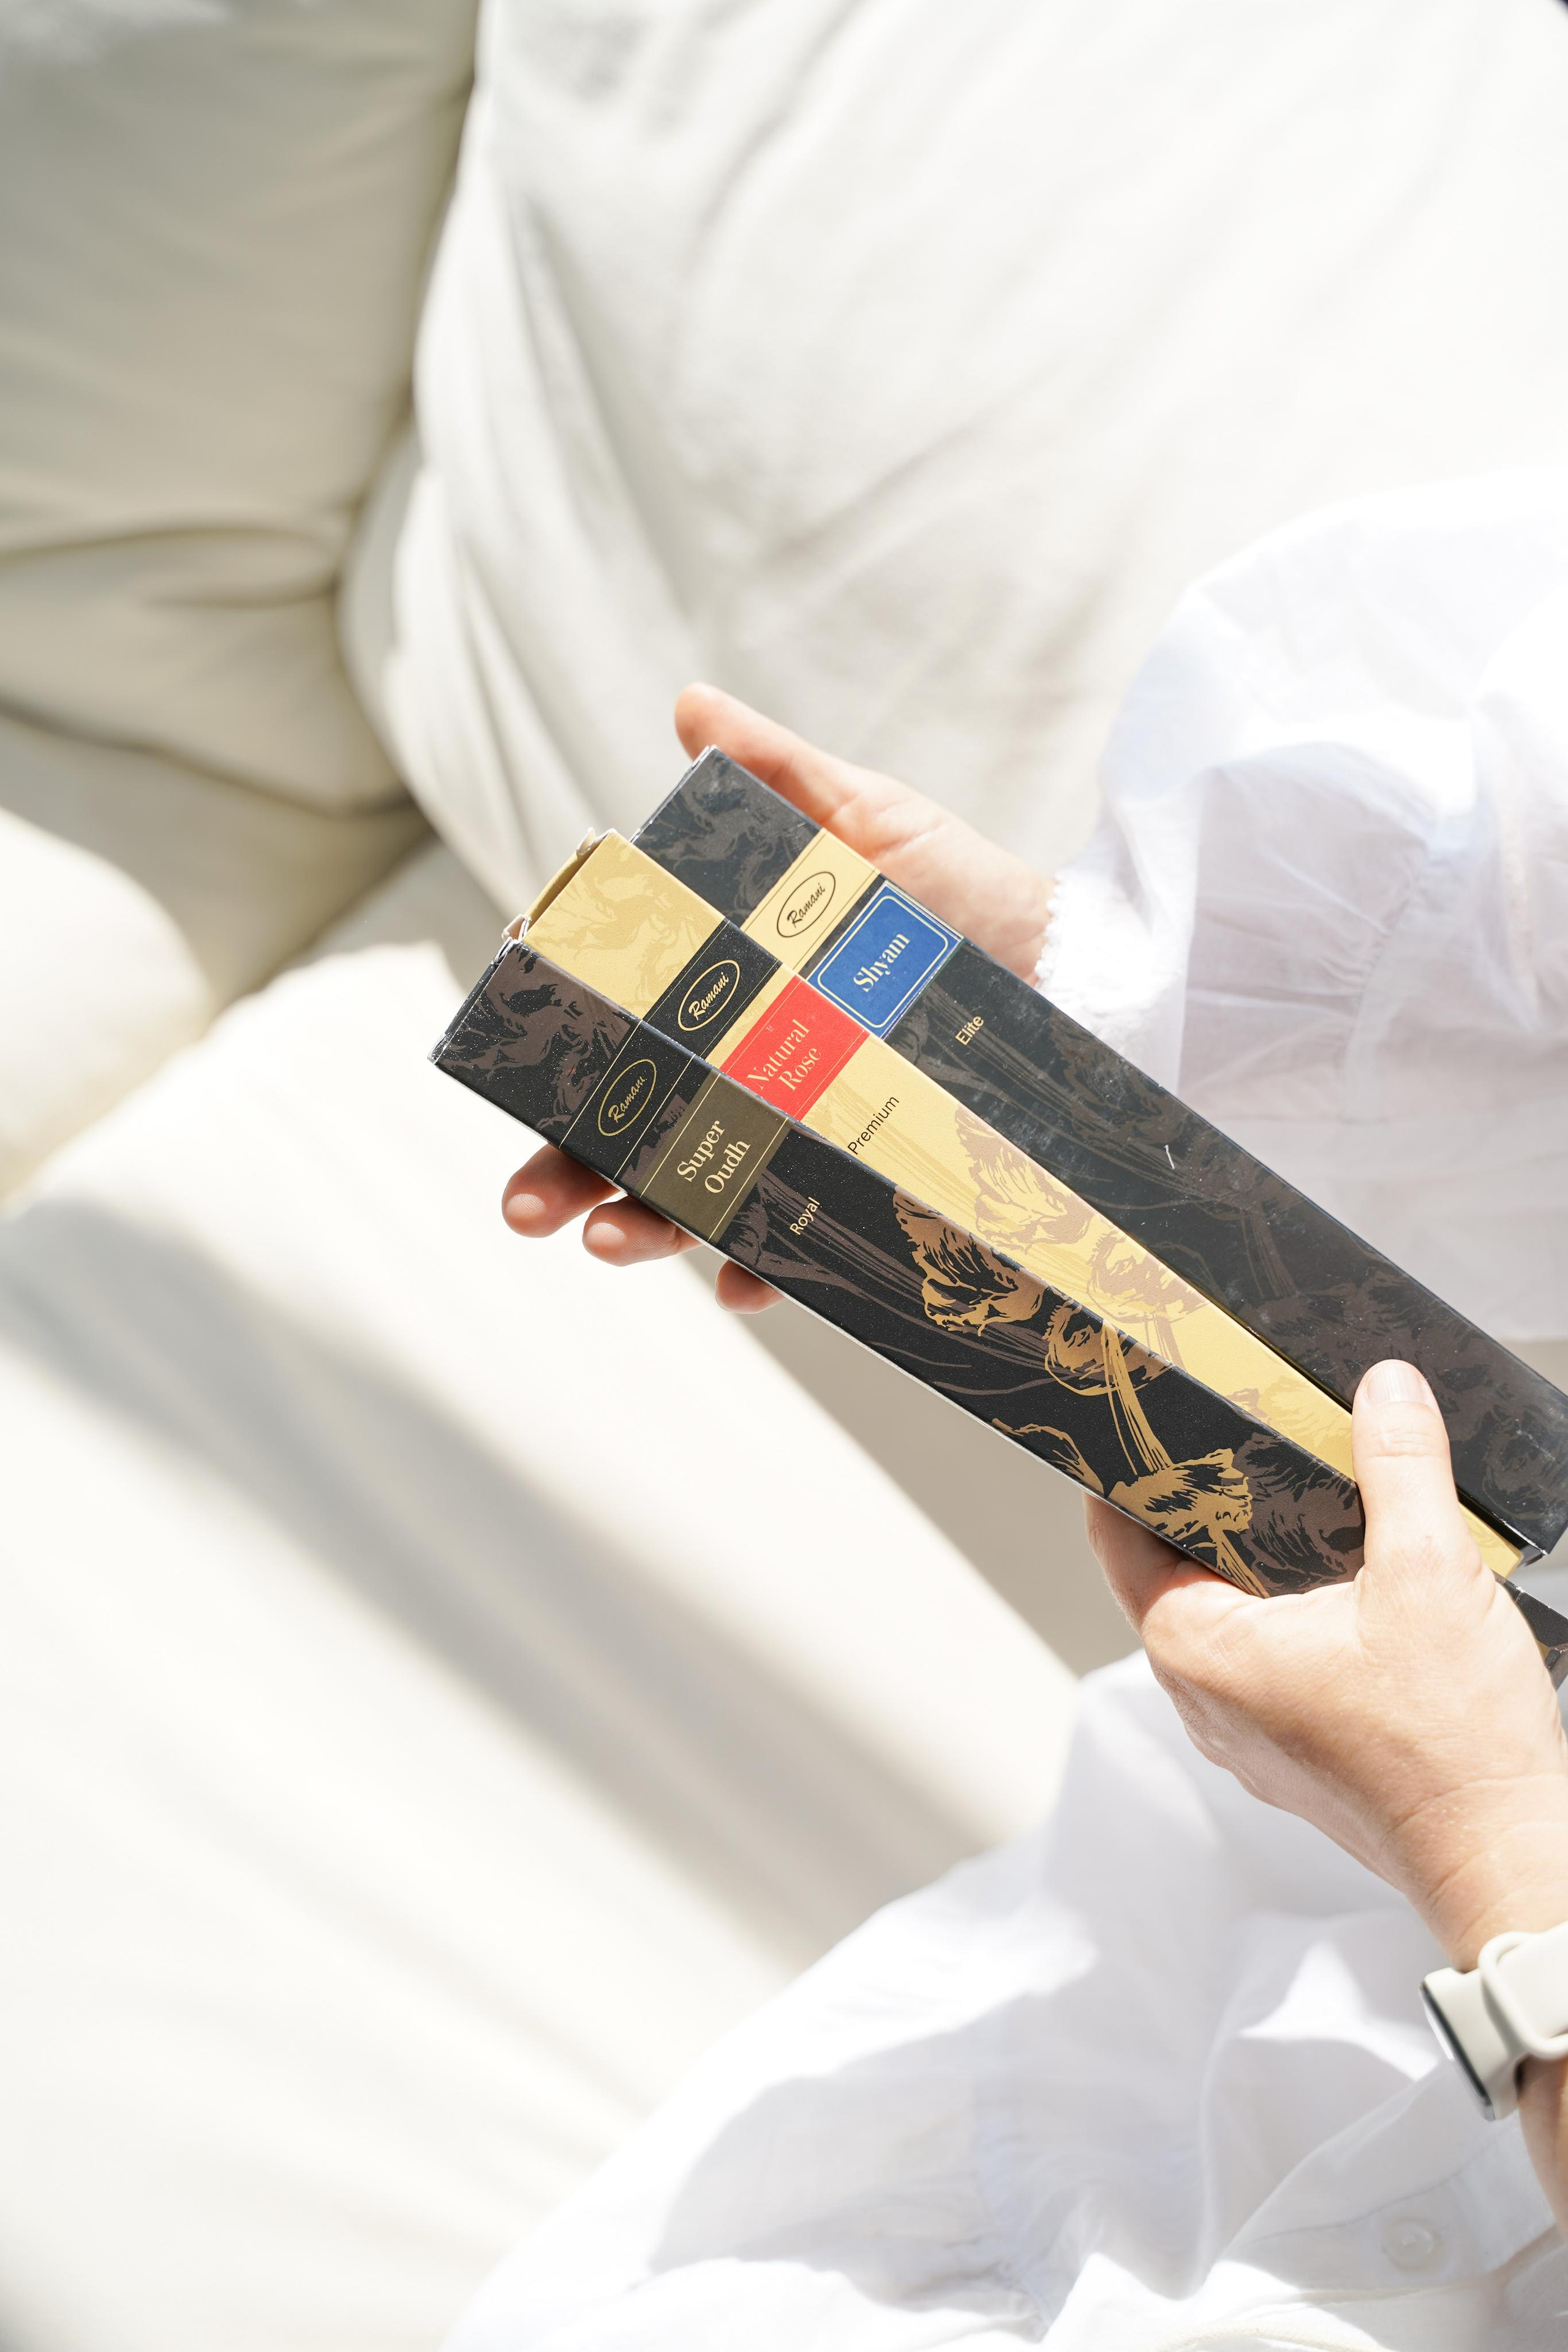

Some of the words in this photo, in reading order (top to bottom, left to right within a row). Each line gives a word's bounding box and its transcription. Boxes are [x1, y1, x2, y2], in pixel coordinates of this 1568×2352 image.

[787, 883, 826, 928] Ramani
[853, 932, 910, 992] Shyam
[688, 972, 729, 1020] Ramani
[746, 1019, 810, 1090] Natural
[956, 1016, 984, 1046] Elite
[778, 1048, 821, 1091] Rose
[677, 1120, 725, 1183] Super
[847, 1096, 900, 1155] Premium
[705, 1139, 750, 1195] Oudh
[790, 1197, 820, 1236] Royal
